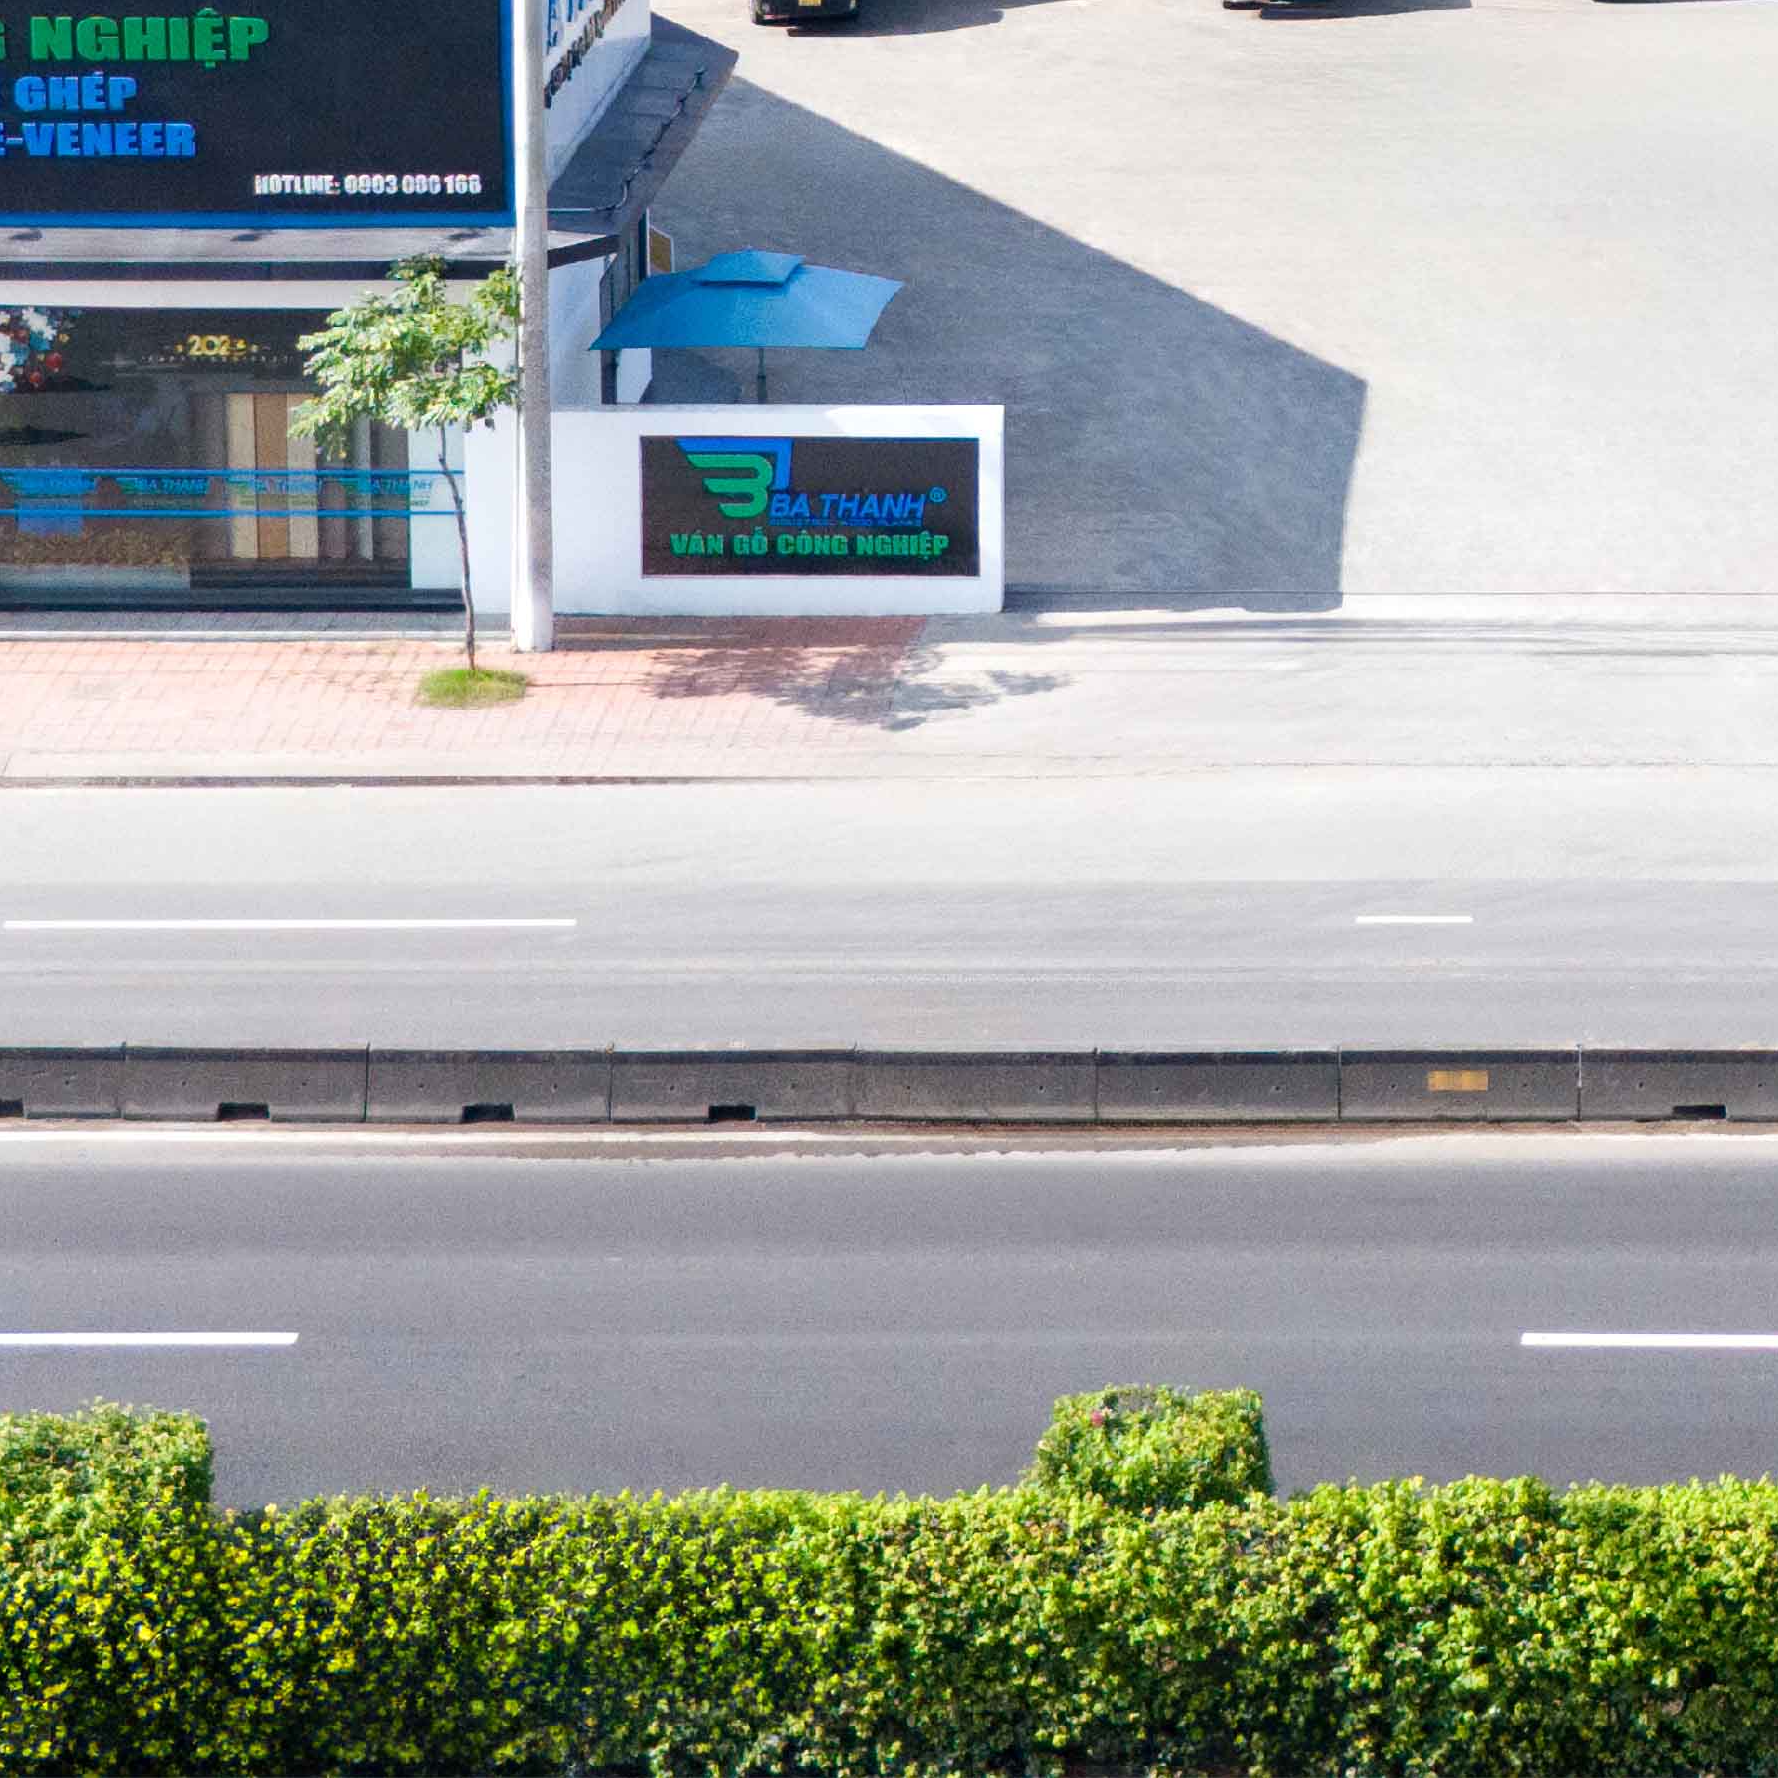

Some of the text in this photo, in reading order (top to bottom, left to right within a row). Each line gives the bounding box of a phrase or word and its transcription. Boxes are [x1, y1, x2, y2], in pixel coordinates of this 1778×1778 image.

[31, 8, 270, 69] NGHIỆP
[14, 71, 138, 112] GHÉP
[254, 174, 341, 195] HOTLINE:
[770, 493, 810, 518] BA
[670, 526, 949, 560] VÁN GỖ CÔNG NGHIỆP
